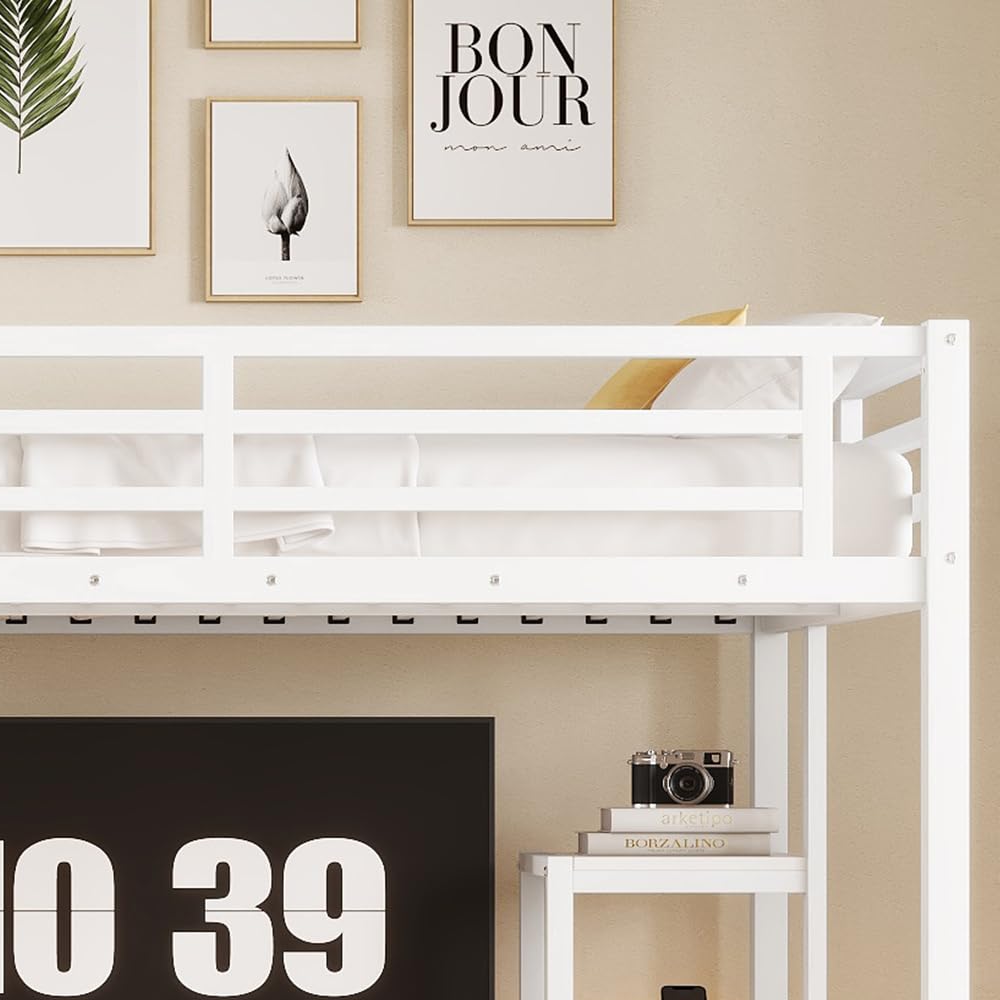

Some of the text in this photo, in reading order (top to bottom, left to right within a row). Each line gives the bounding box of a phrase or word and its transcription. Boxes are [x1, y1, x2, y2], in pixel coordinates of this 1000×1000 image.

[444, 22, 581, 75] BON
[430, 74, 596, 132] JOUR
[444, 138, 581, 151] mon ami
[662, 811, 733, 828] arketipo
[624, 837, 726, 849] BORZALINO
[172, 837, 386, 998] 39
